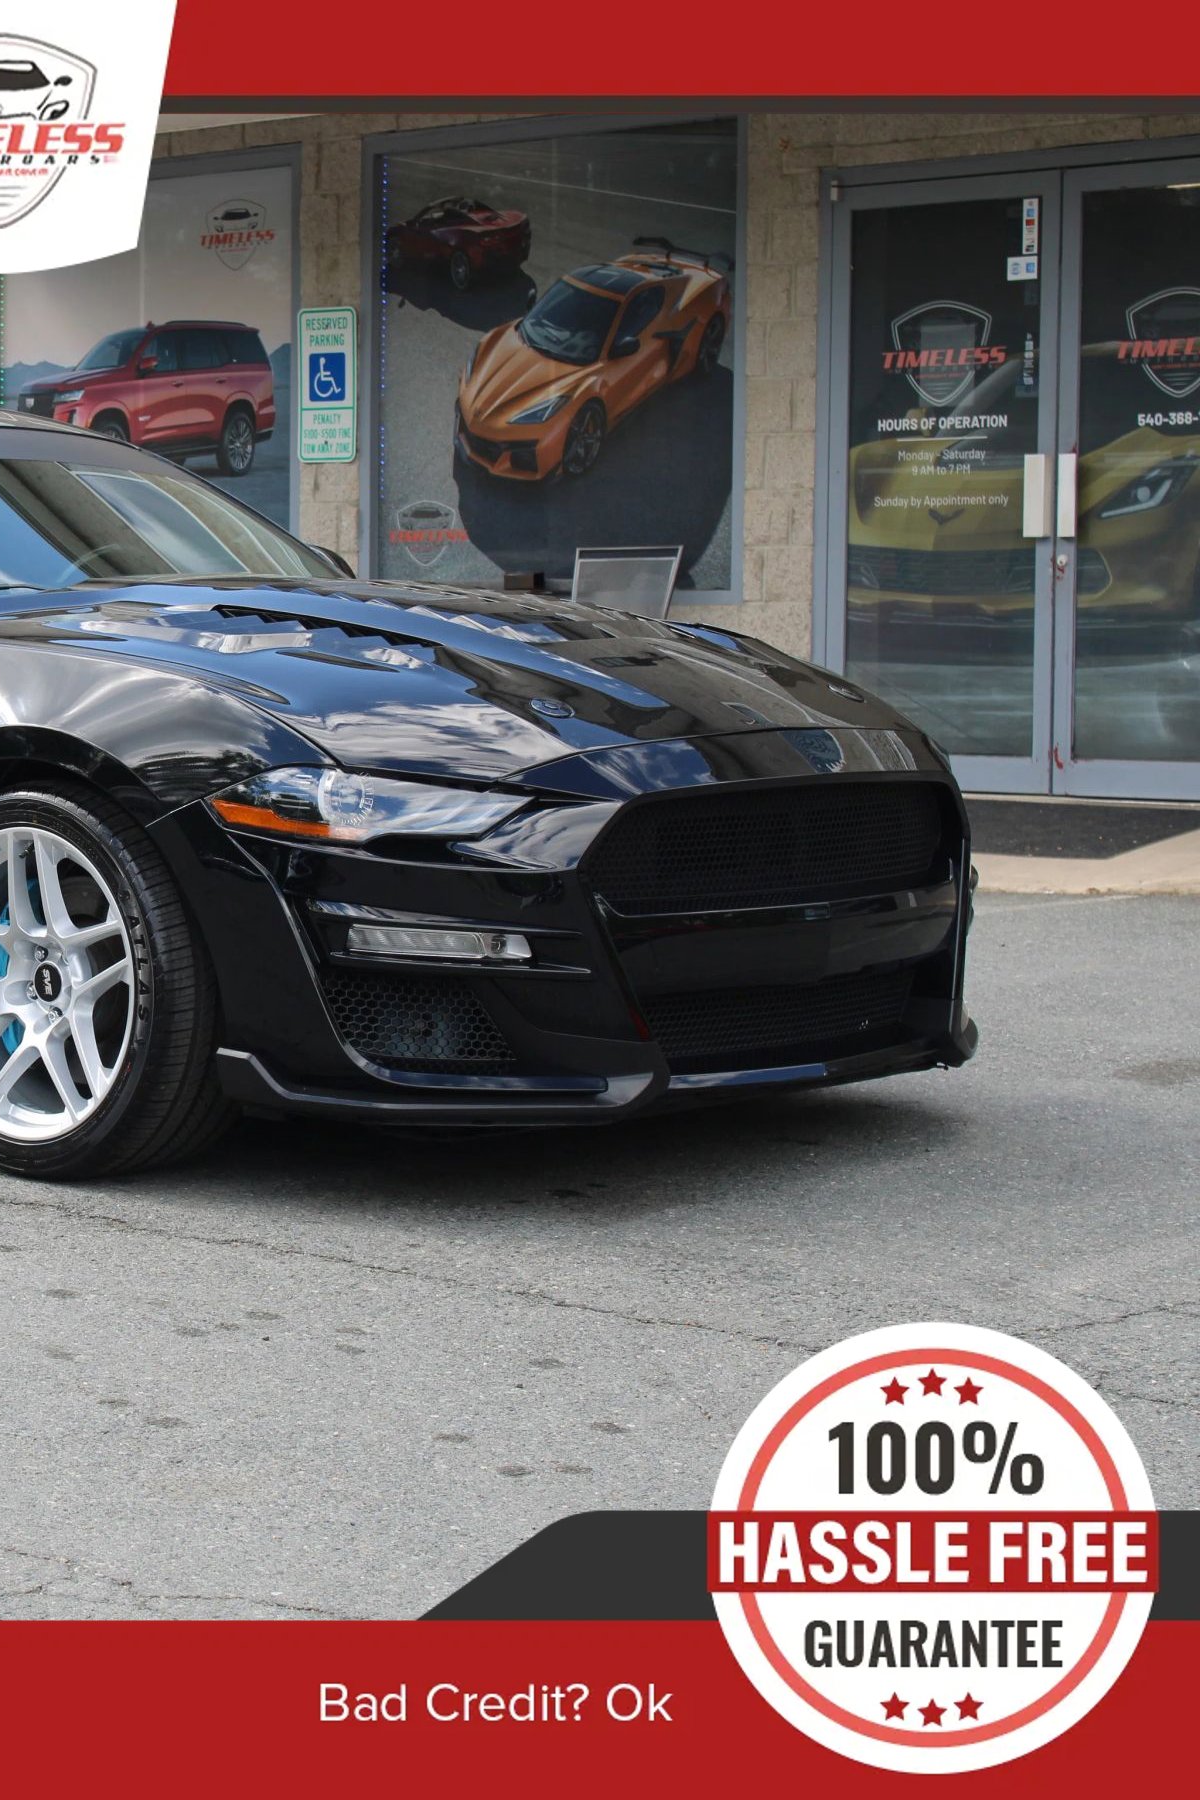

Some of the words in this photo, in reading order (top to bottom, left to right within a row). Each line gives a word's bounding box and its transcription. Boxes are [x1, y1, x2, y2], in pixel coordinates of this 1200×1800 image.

[200, 229, 276, 247] TIMELESS
[306, 317, 348, 330] RESERVED
[310, 334, 344, 346] PARKING
[1117, 337, 1200, 360] TIMEL
[881, 346, 1007, 369] TIMELESS
[313, 413, 341, 424] PENALTY
[877, 418, 918, 432] HOURS
[920, 417, 936, 430] OF
[938, 414, 1008, 429] OPERATION
[1137, 411, 1200, 427] 540-368-
[339, 427, 351, 438] FINE
[304, 443, 316, 453] TOW
[317, 442, 332, 453] AWAY
[335, 441, 350, 453] ZONE
[898, 450, 934, 462] Monday
[942, 448, 986, 461] Saturday
[920, 466, 935, 476] AM
[937, 466, 947, 475] to
[956, 464, 971, 475] PM
[874, 496, 908, 508] Sunday
[911, 495, 922, 508] by
[923, 495, 987, 508] Appointment
[988, 493, 1009, 507] only
[127, 915, 150, 1021] ATLAS
[42, 968, 53, 997] SVE
